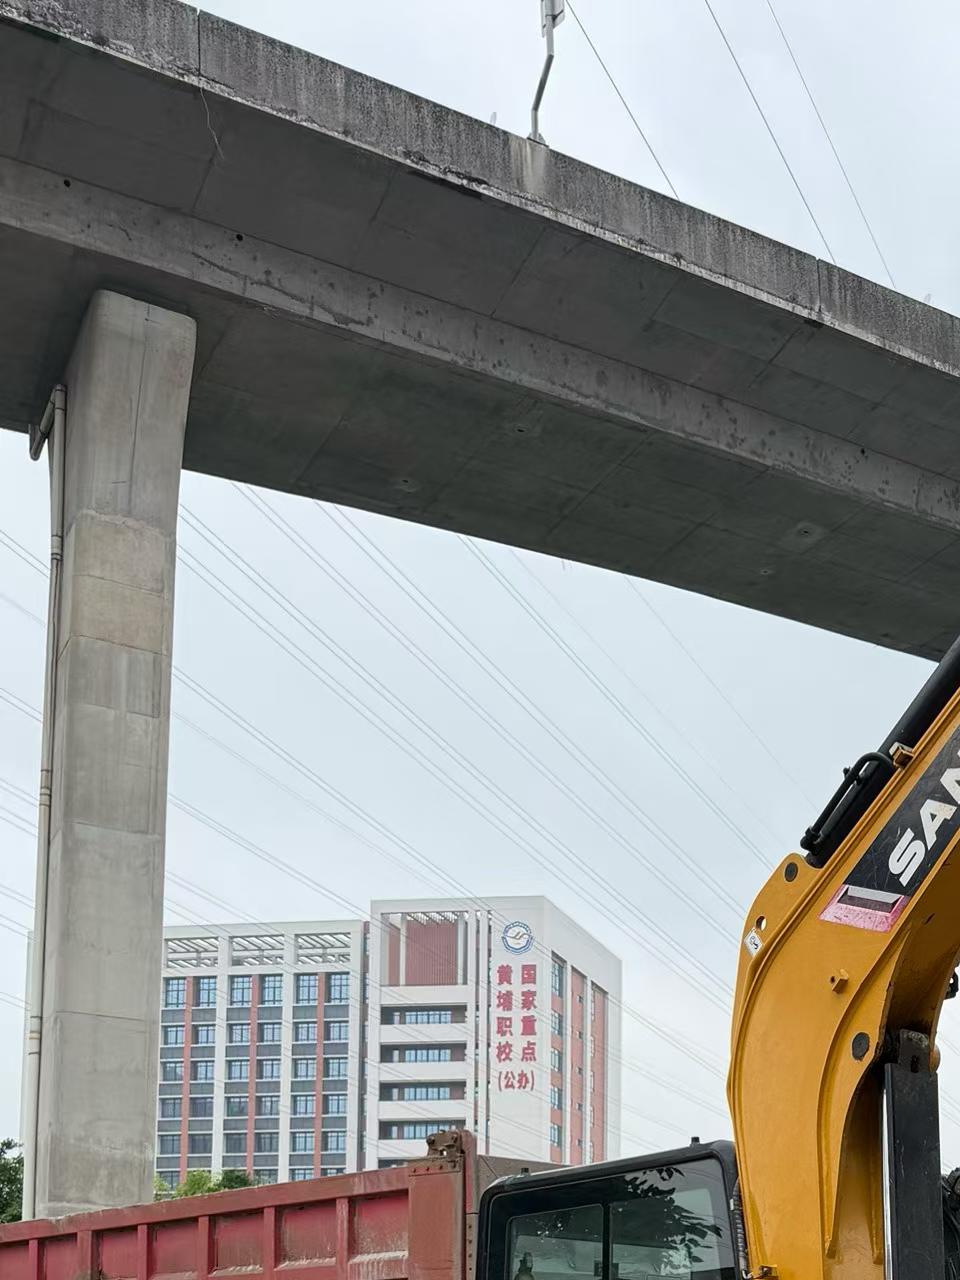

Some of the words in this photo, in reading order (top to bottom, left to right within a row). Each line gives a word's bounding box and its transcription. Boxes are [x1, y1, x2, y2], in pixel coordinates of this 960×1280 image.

[496, 964, 513, 1063] 黄埔职校
[521, 964, 537, 1062] 国家重点
